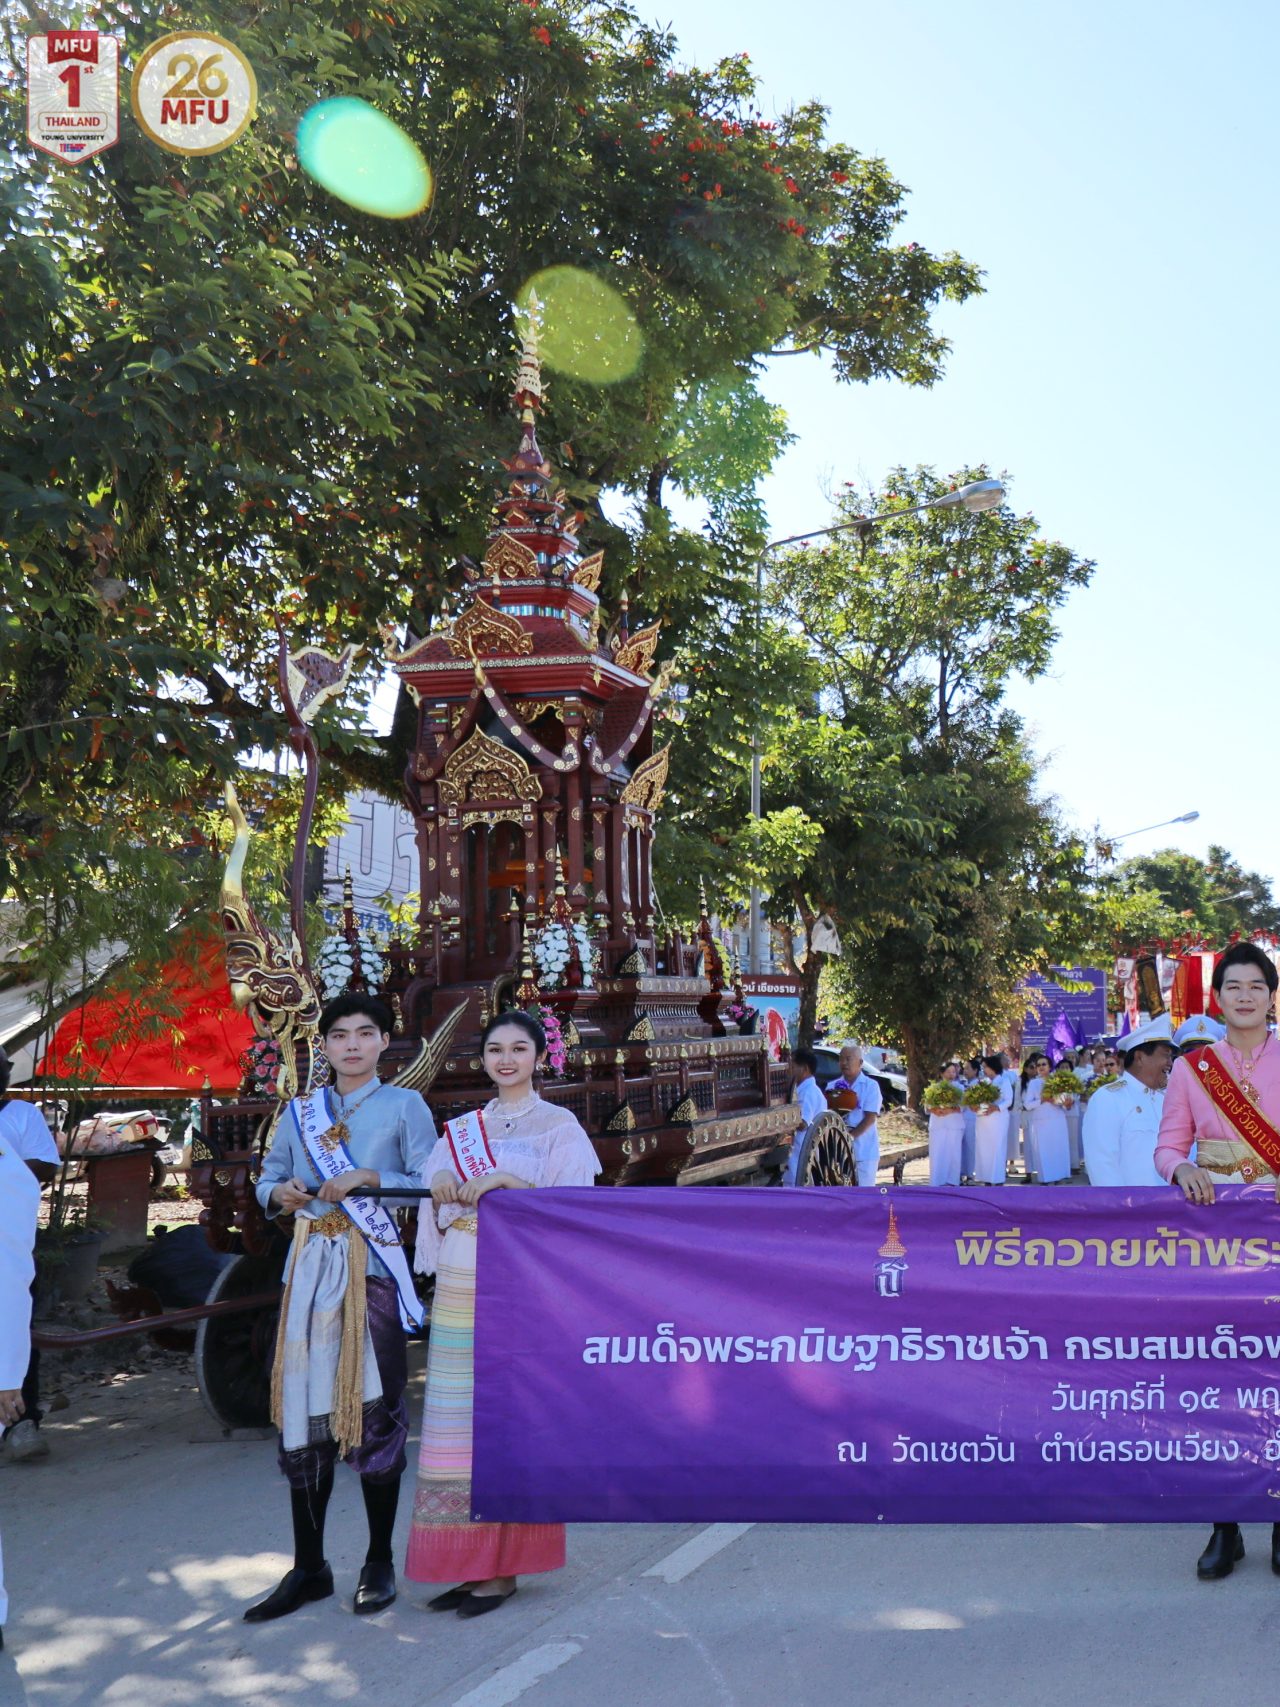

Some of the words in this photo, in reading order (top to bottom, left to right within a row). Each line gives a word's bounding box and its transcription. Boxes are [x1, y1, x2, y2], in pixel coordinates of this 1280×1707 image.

[757, 981, 796, 994] เชียงราย
[582, 1322, 1048, 1372] สมเด็จพระกนิษฐาธิราชเจ้า
[1051, 1375, 1166, 1420] วันศุกร์ที่
[1178, 1386, 1220, 1415] ๑๕
[837, 1441, 868, 1463] ณ
[893, 1433, 1015, 1463] วัดเชตวัน
[1041, 1432, 1240, 1463] ตำบลรอบเวียง
